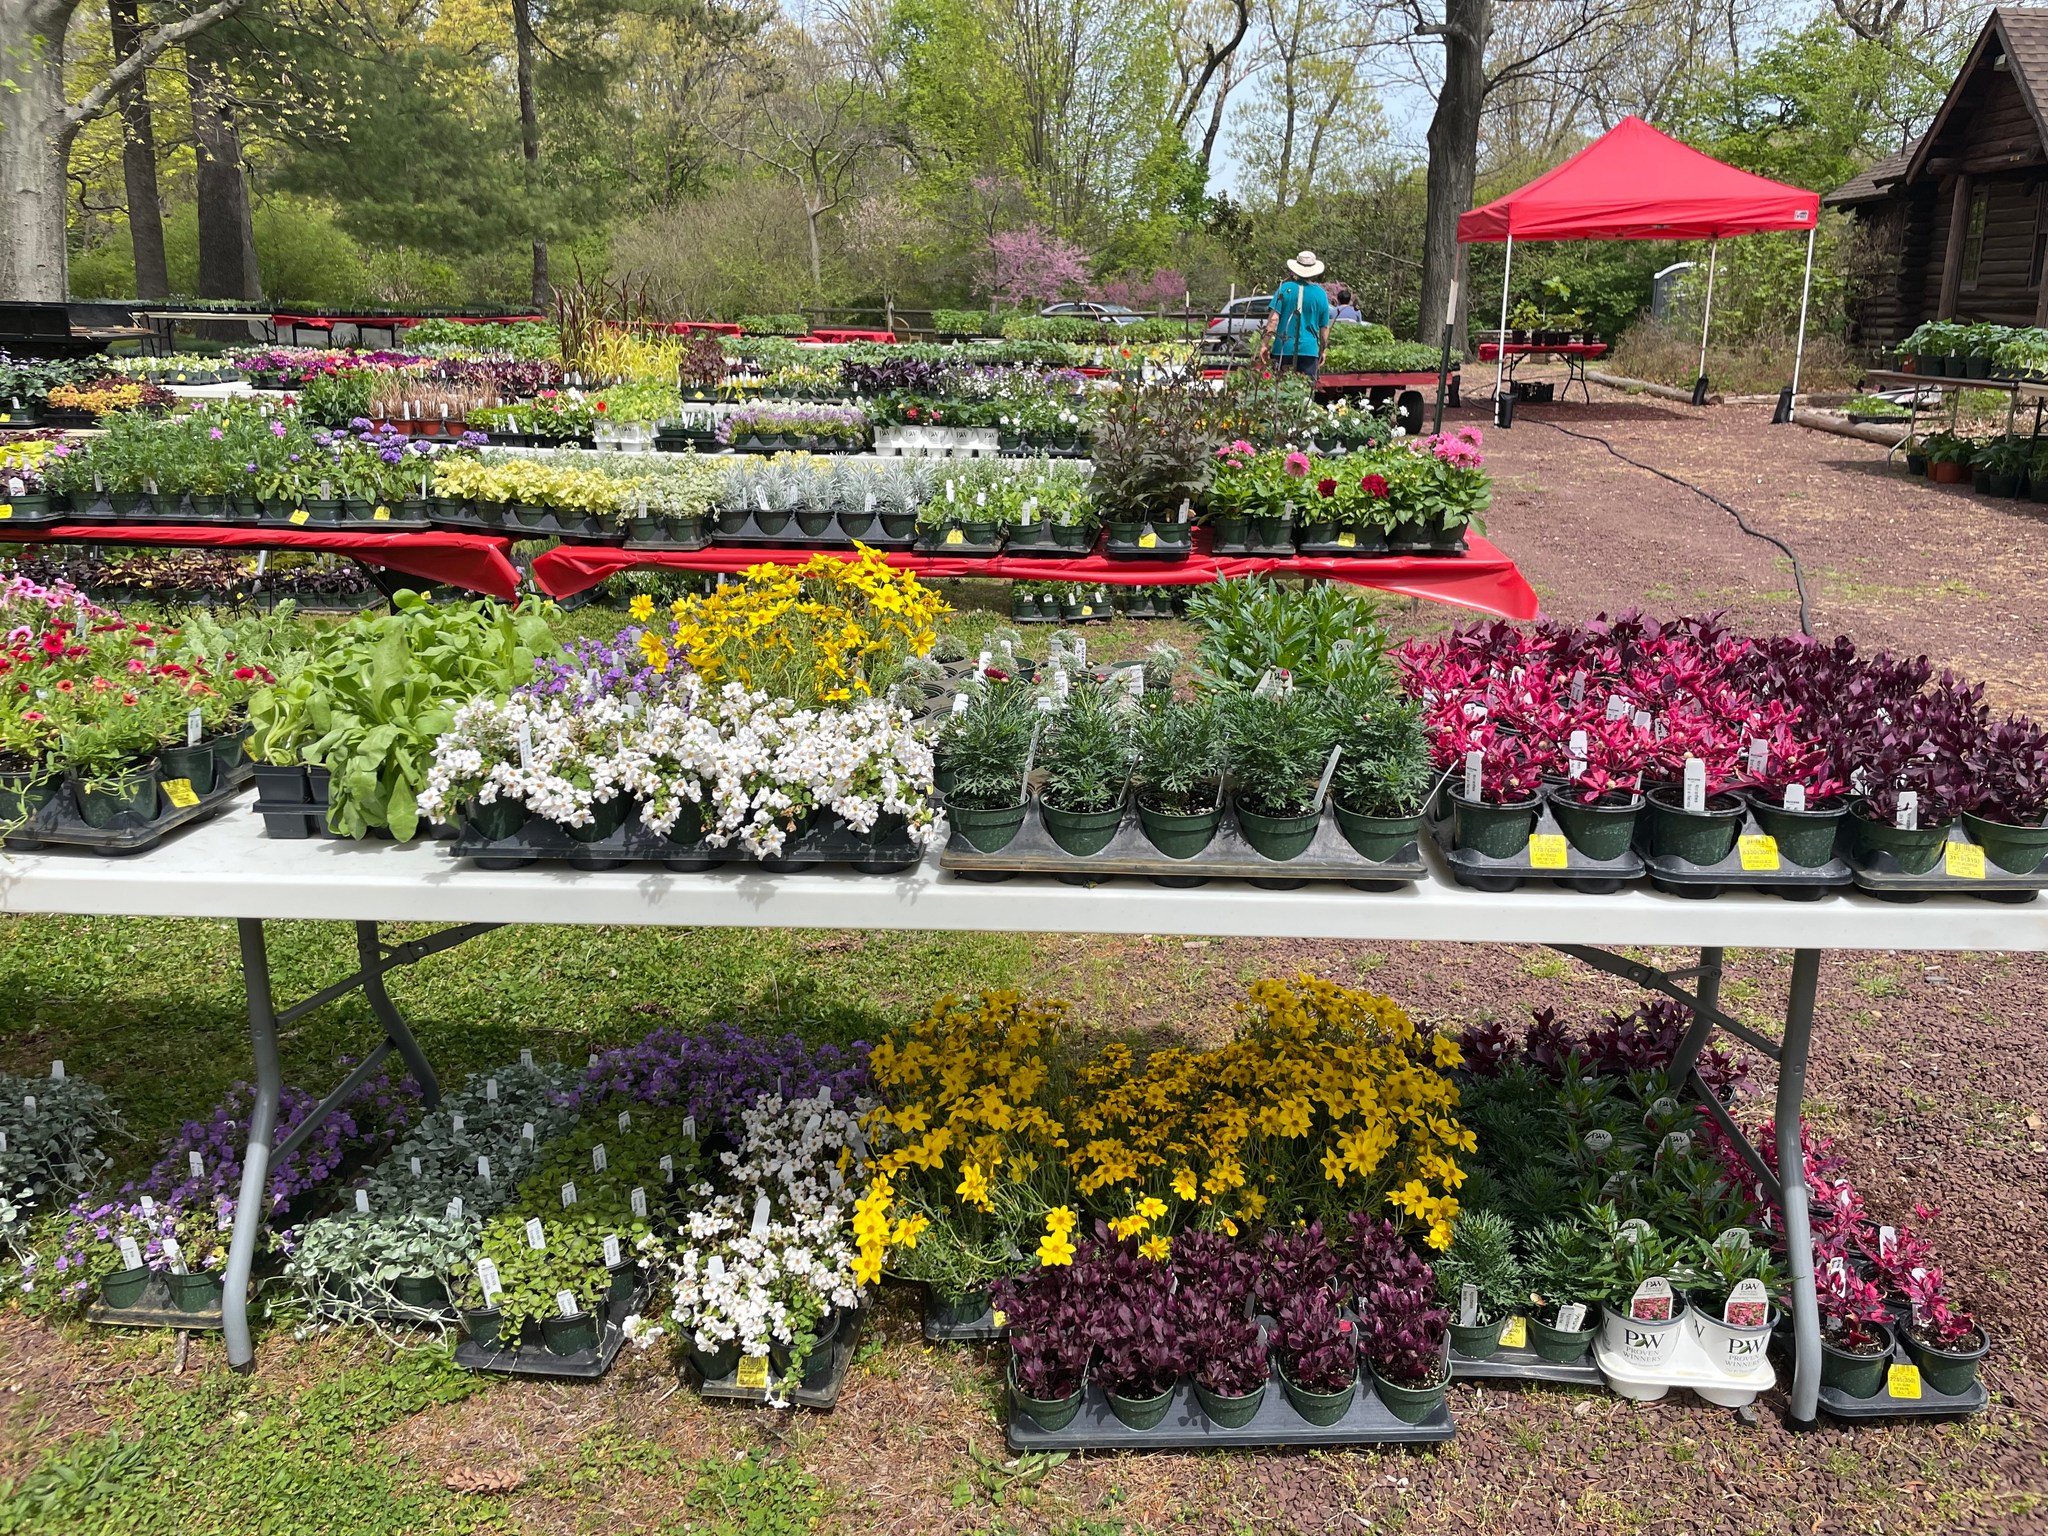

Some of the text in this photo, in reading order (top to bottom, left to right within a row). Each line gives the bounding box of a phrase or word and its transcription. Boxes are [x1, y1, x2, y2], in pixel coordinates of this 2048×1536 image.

[1645, 1280, 1664, 1288] PW
[1740, 1283, 1760, 1291] PW
[1623, 1327, 1665, 1349] PW
[1728, 1336, 1766, 1355] PW
[1625, 1346, 1659, 1356] PROVEN
[1622, 1351, 1662, 1362] WINNERS
[1728, 1354, 1760, 1362] PROVEN
